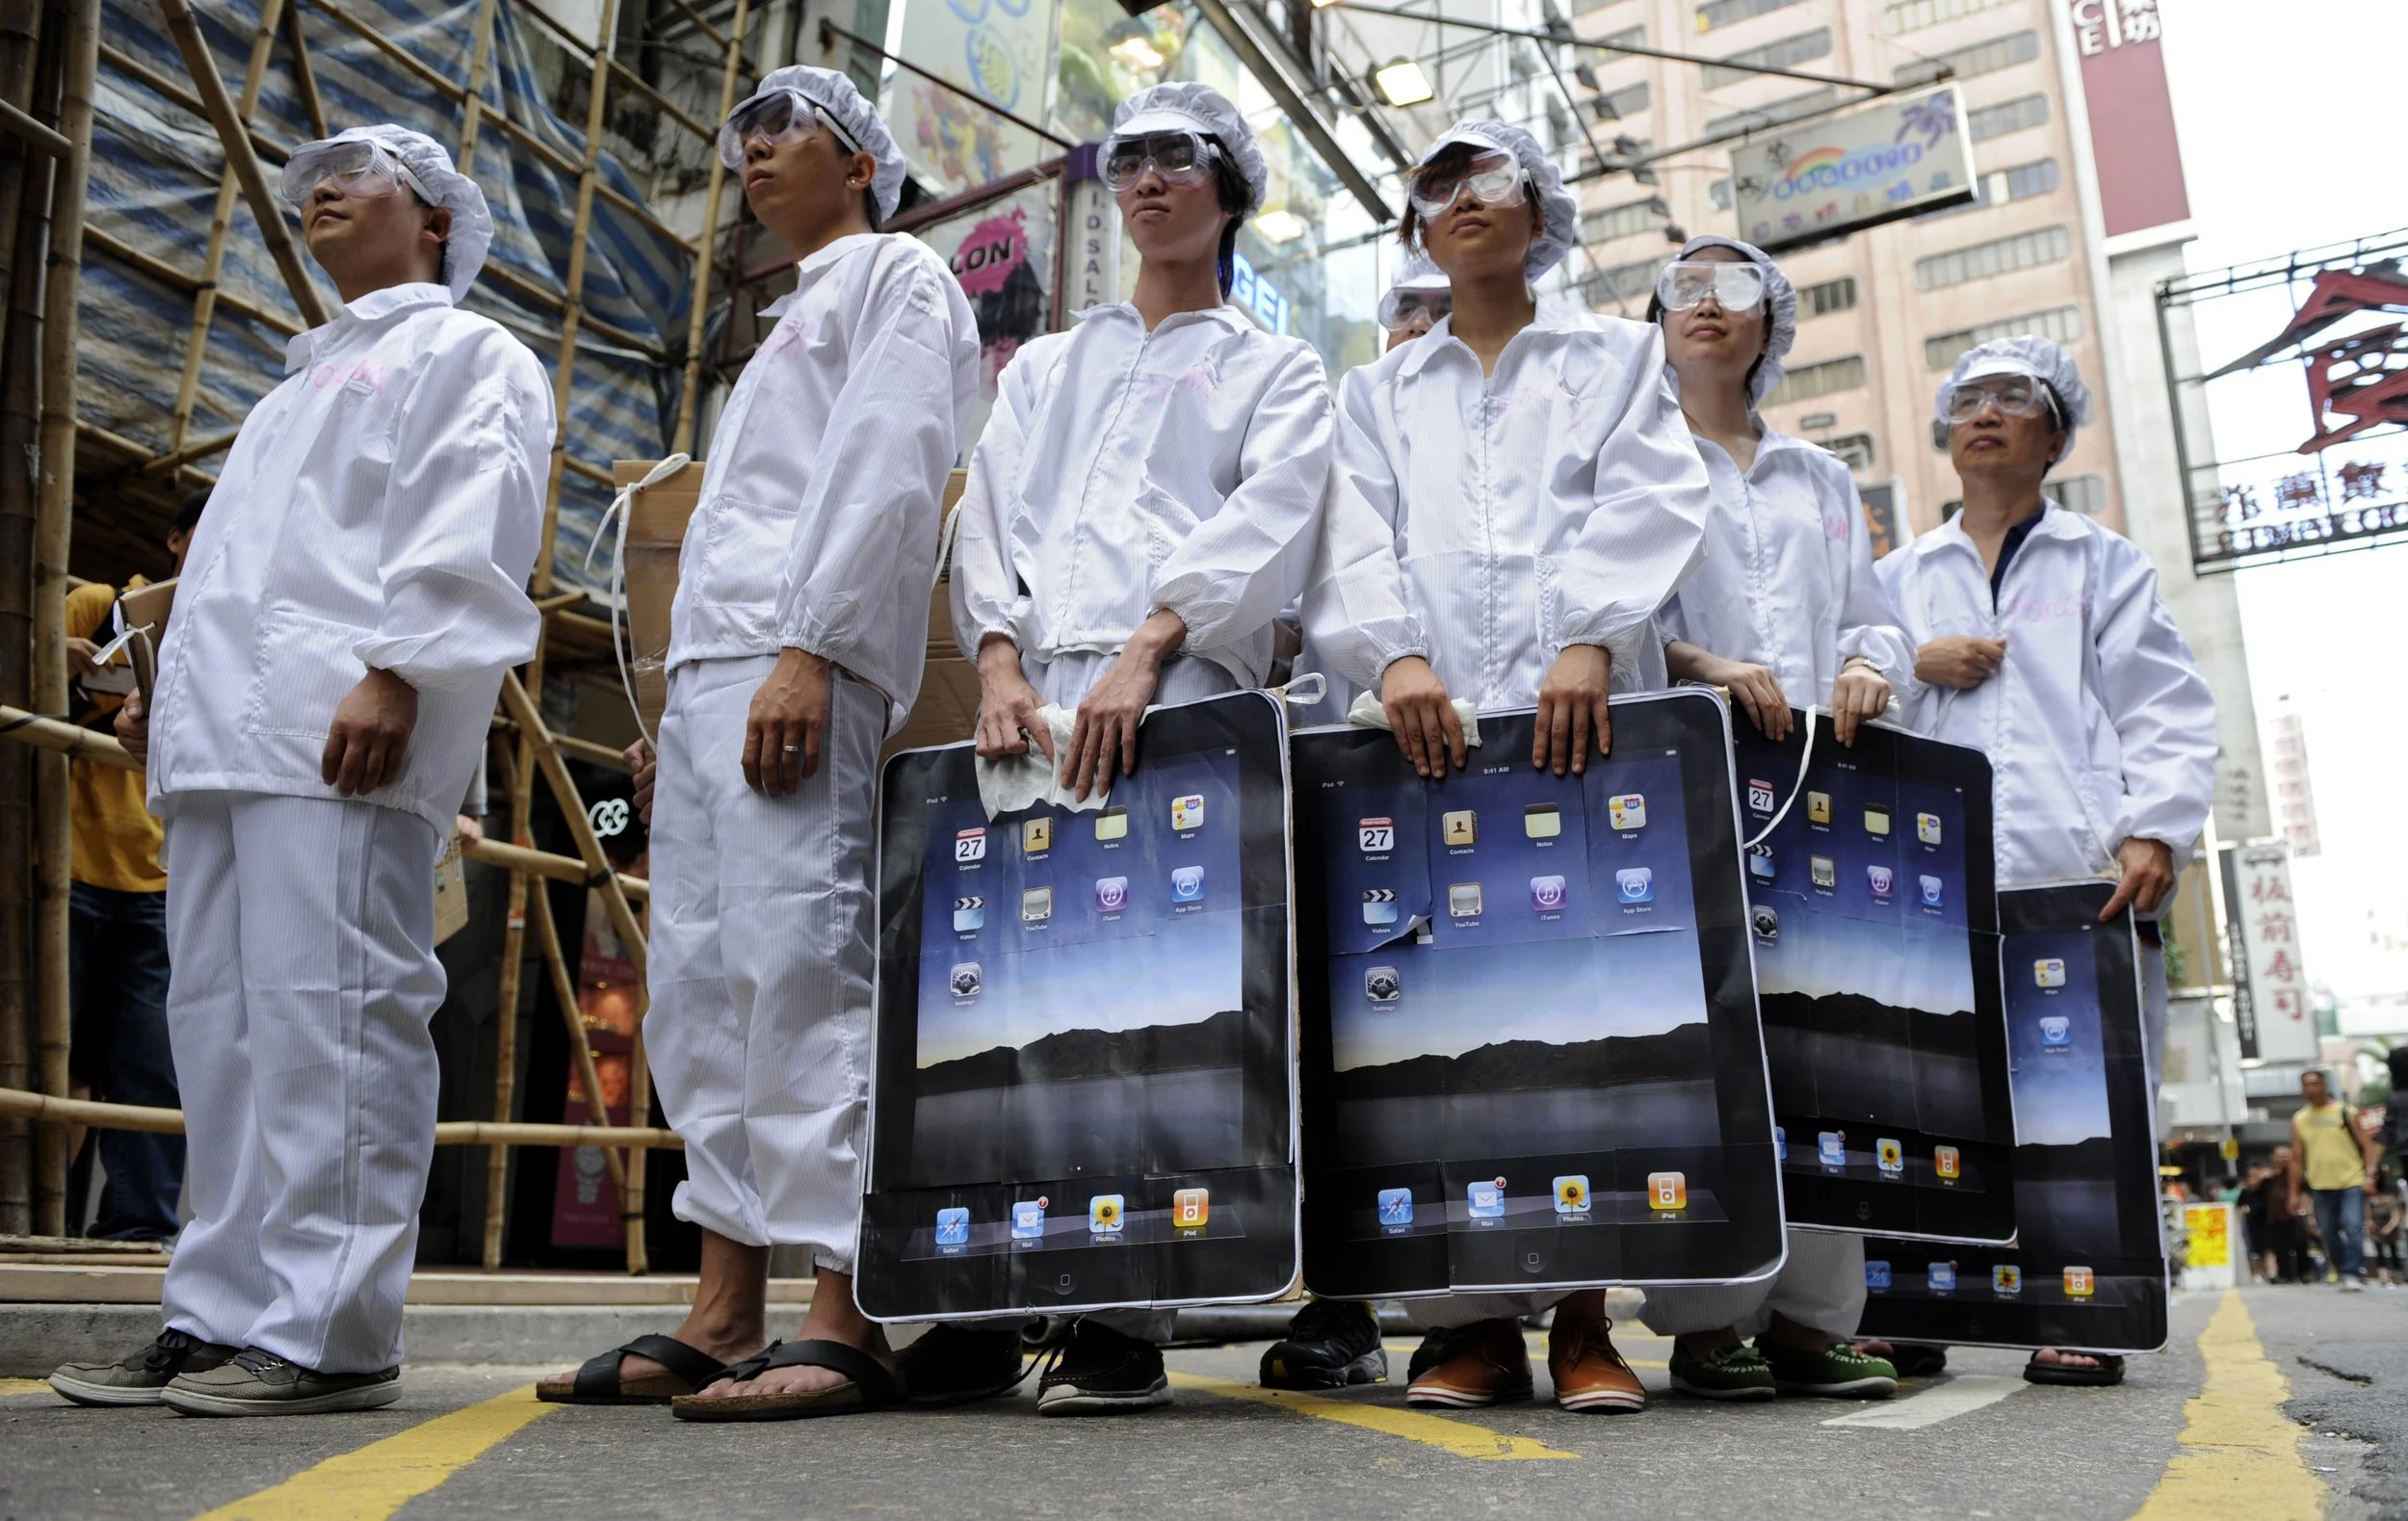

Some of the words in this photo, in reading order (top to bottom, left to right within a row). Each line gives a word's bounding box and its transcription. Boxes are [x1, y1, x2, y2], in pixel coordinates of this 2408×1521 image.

[1752, 790, 1770, 808] 27
[958, 838, 982, 857] 27
[1363, 829, 1389, 848] 27
[1027, 853, 1049, 862] Contacts
[1175, 905, 1187, 914] App
